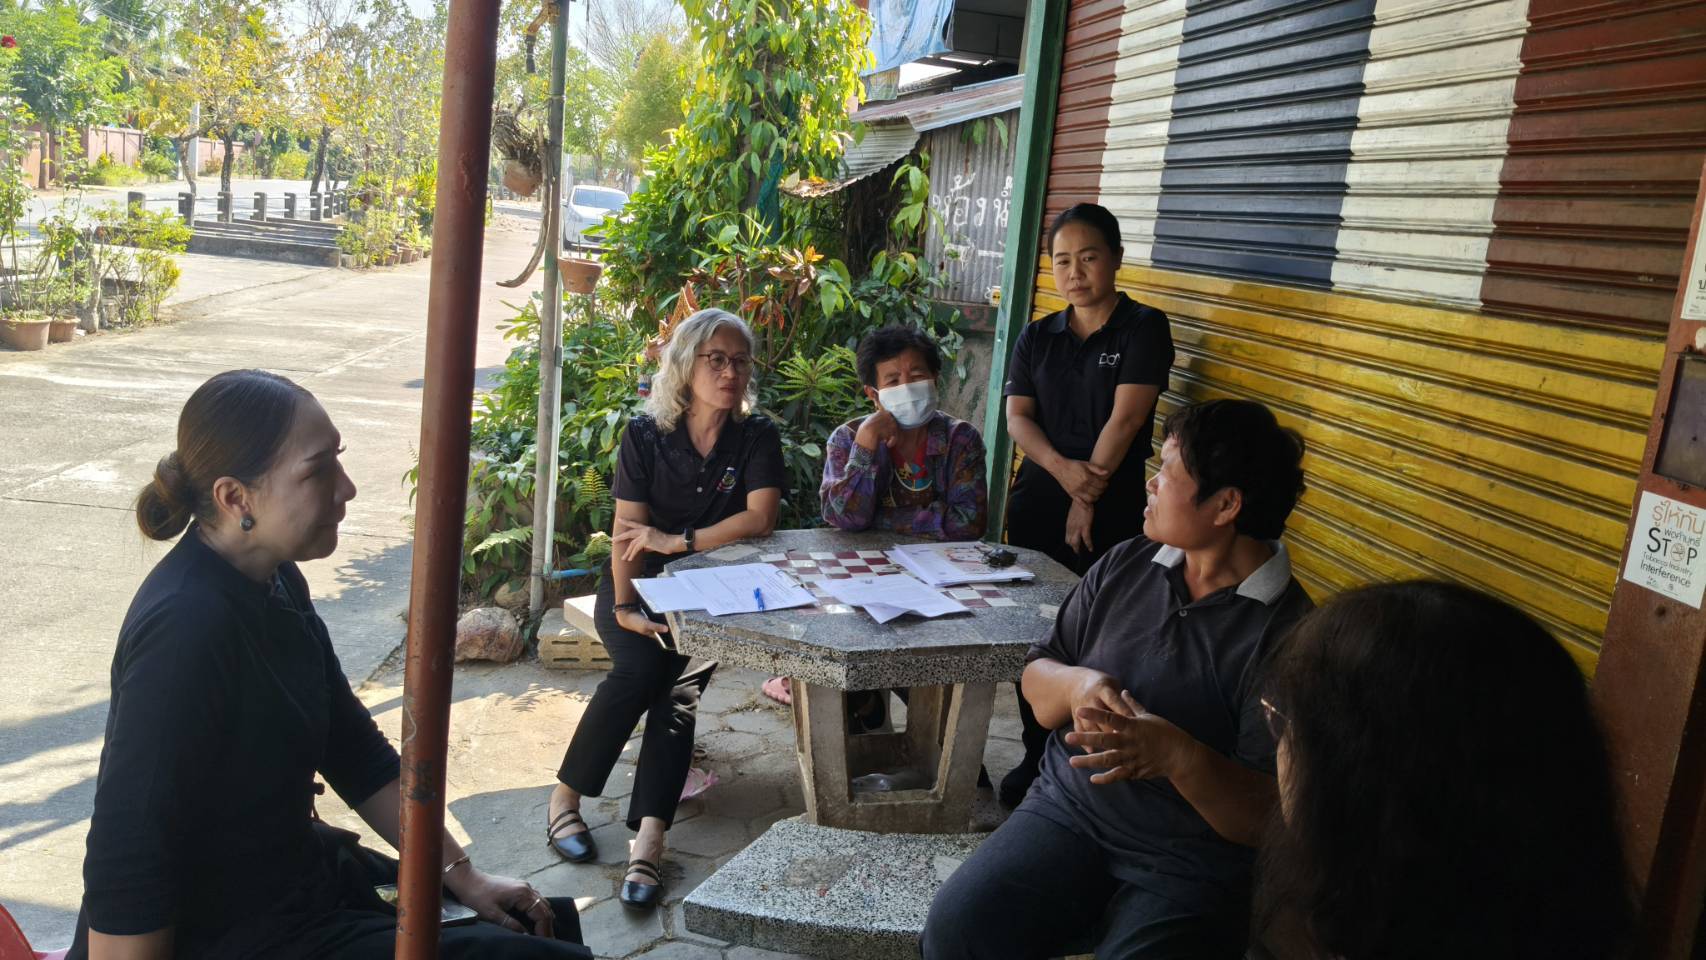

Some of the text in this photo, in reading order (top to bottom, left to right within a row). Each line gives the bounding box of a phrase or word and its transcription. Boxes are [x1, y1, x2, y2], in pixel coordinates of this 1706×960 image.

[1640, 560, 1691, 588] Interference
[1643, 551, 1693, 577] Tobacco Industry
